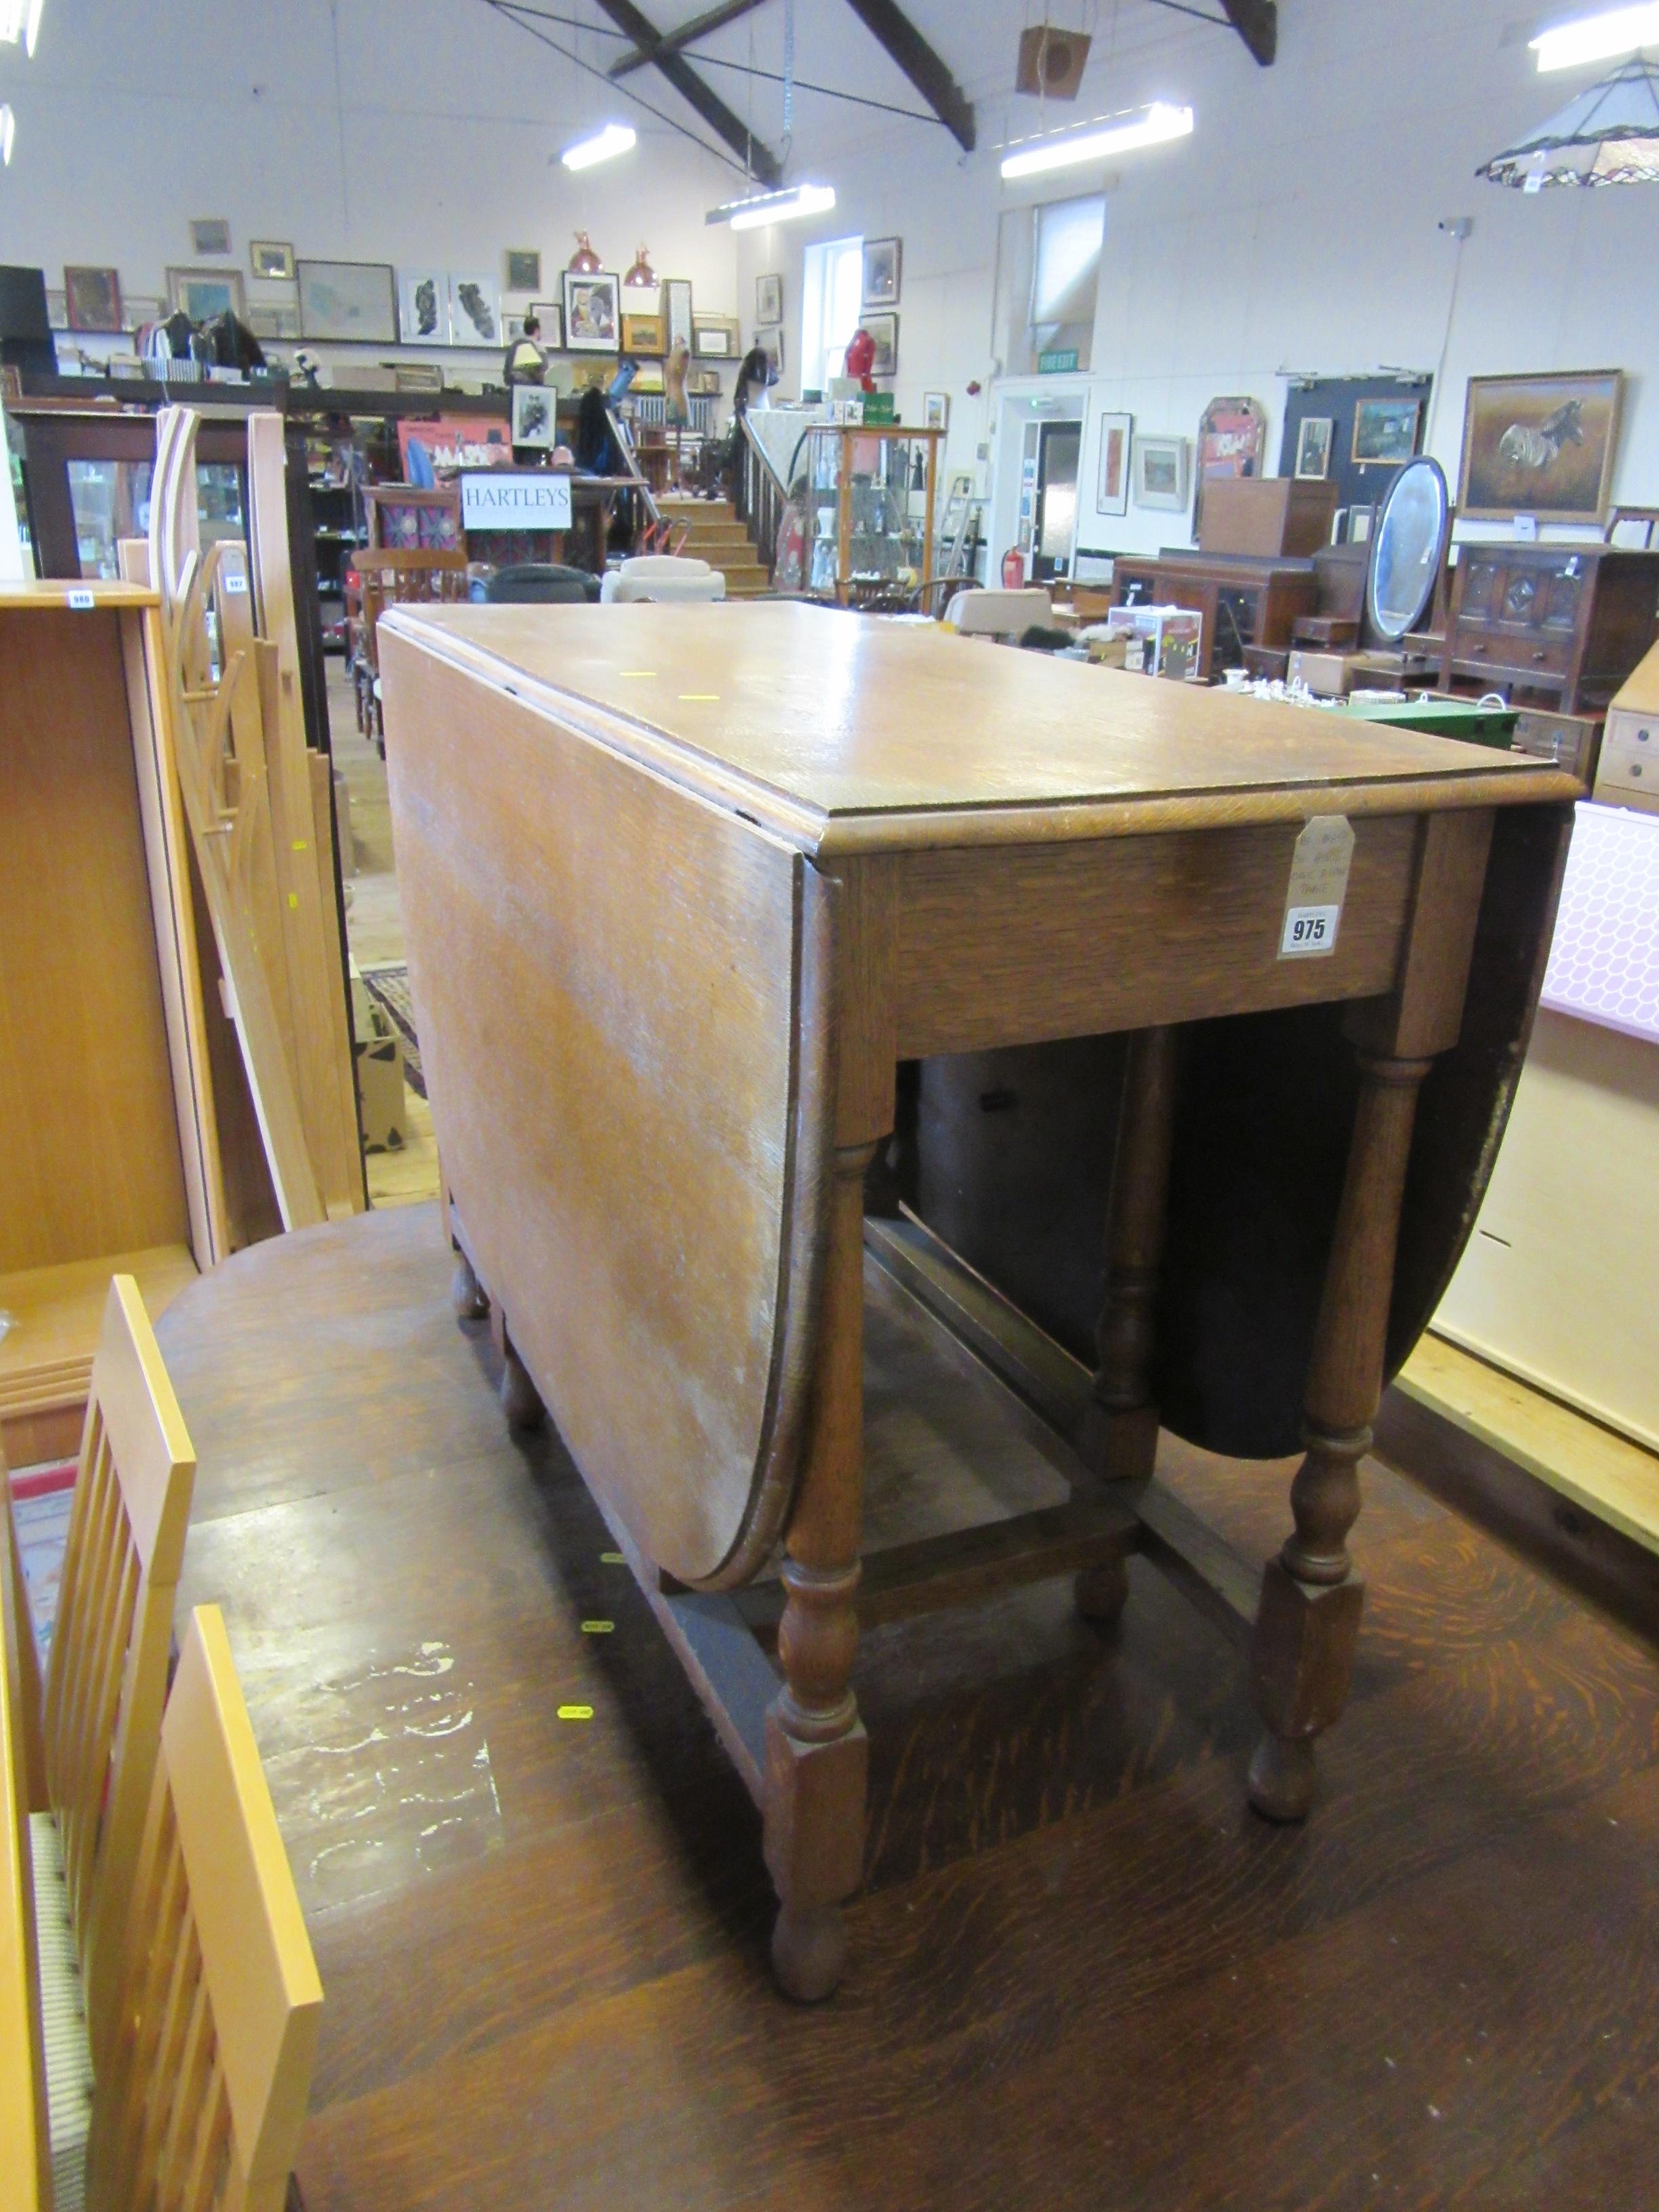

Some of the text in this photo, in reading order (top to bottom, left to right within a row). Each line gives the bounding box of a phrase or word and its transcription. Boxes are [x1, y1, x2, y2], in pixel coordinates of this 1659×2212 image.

[1040, 353, 1074, 370] FIRE EXIT
[466, 488, 569, 507] HARTLEYS
[1293, 919, 1326, 941] 975
